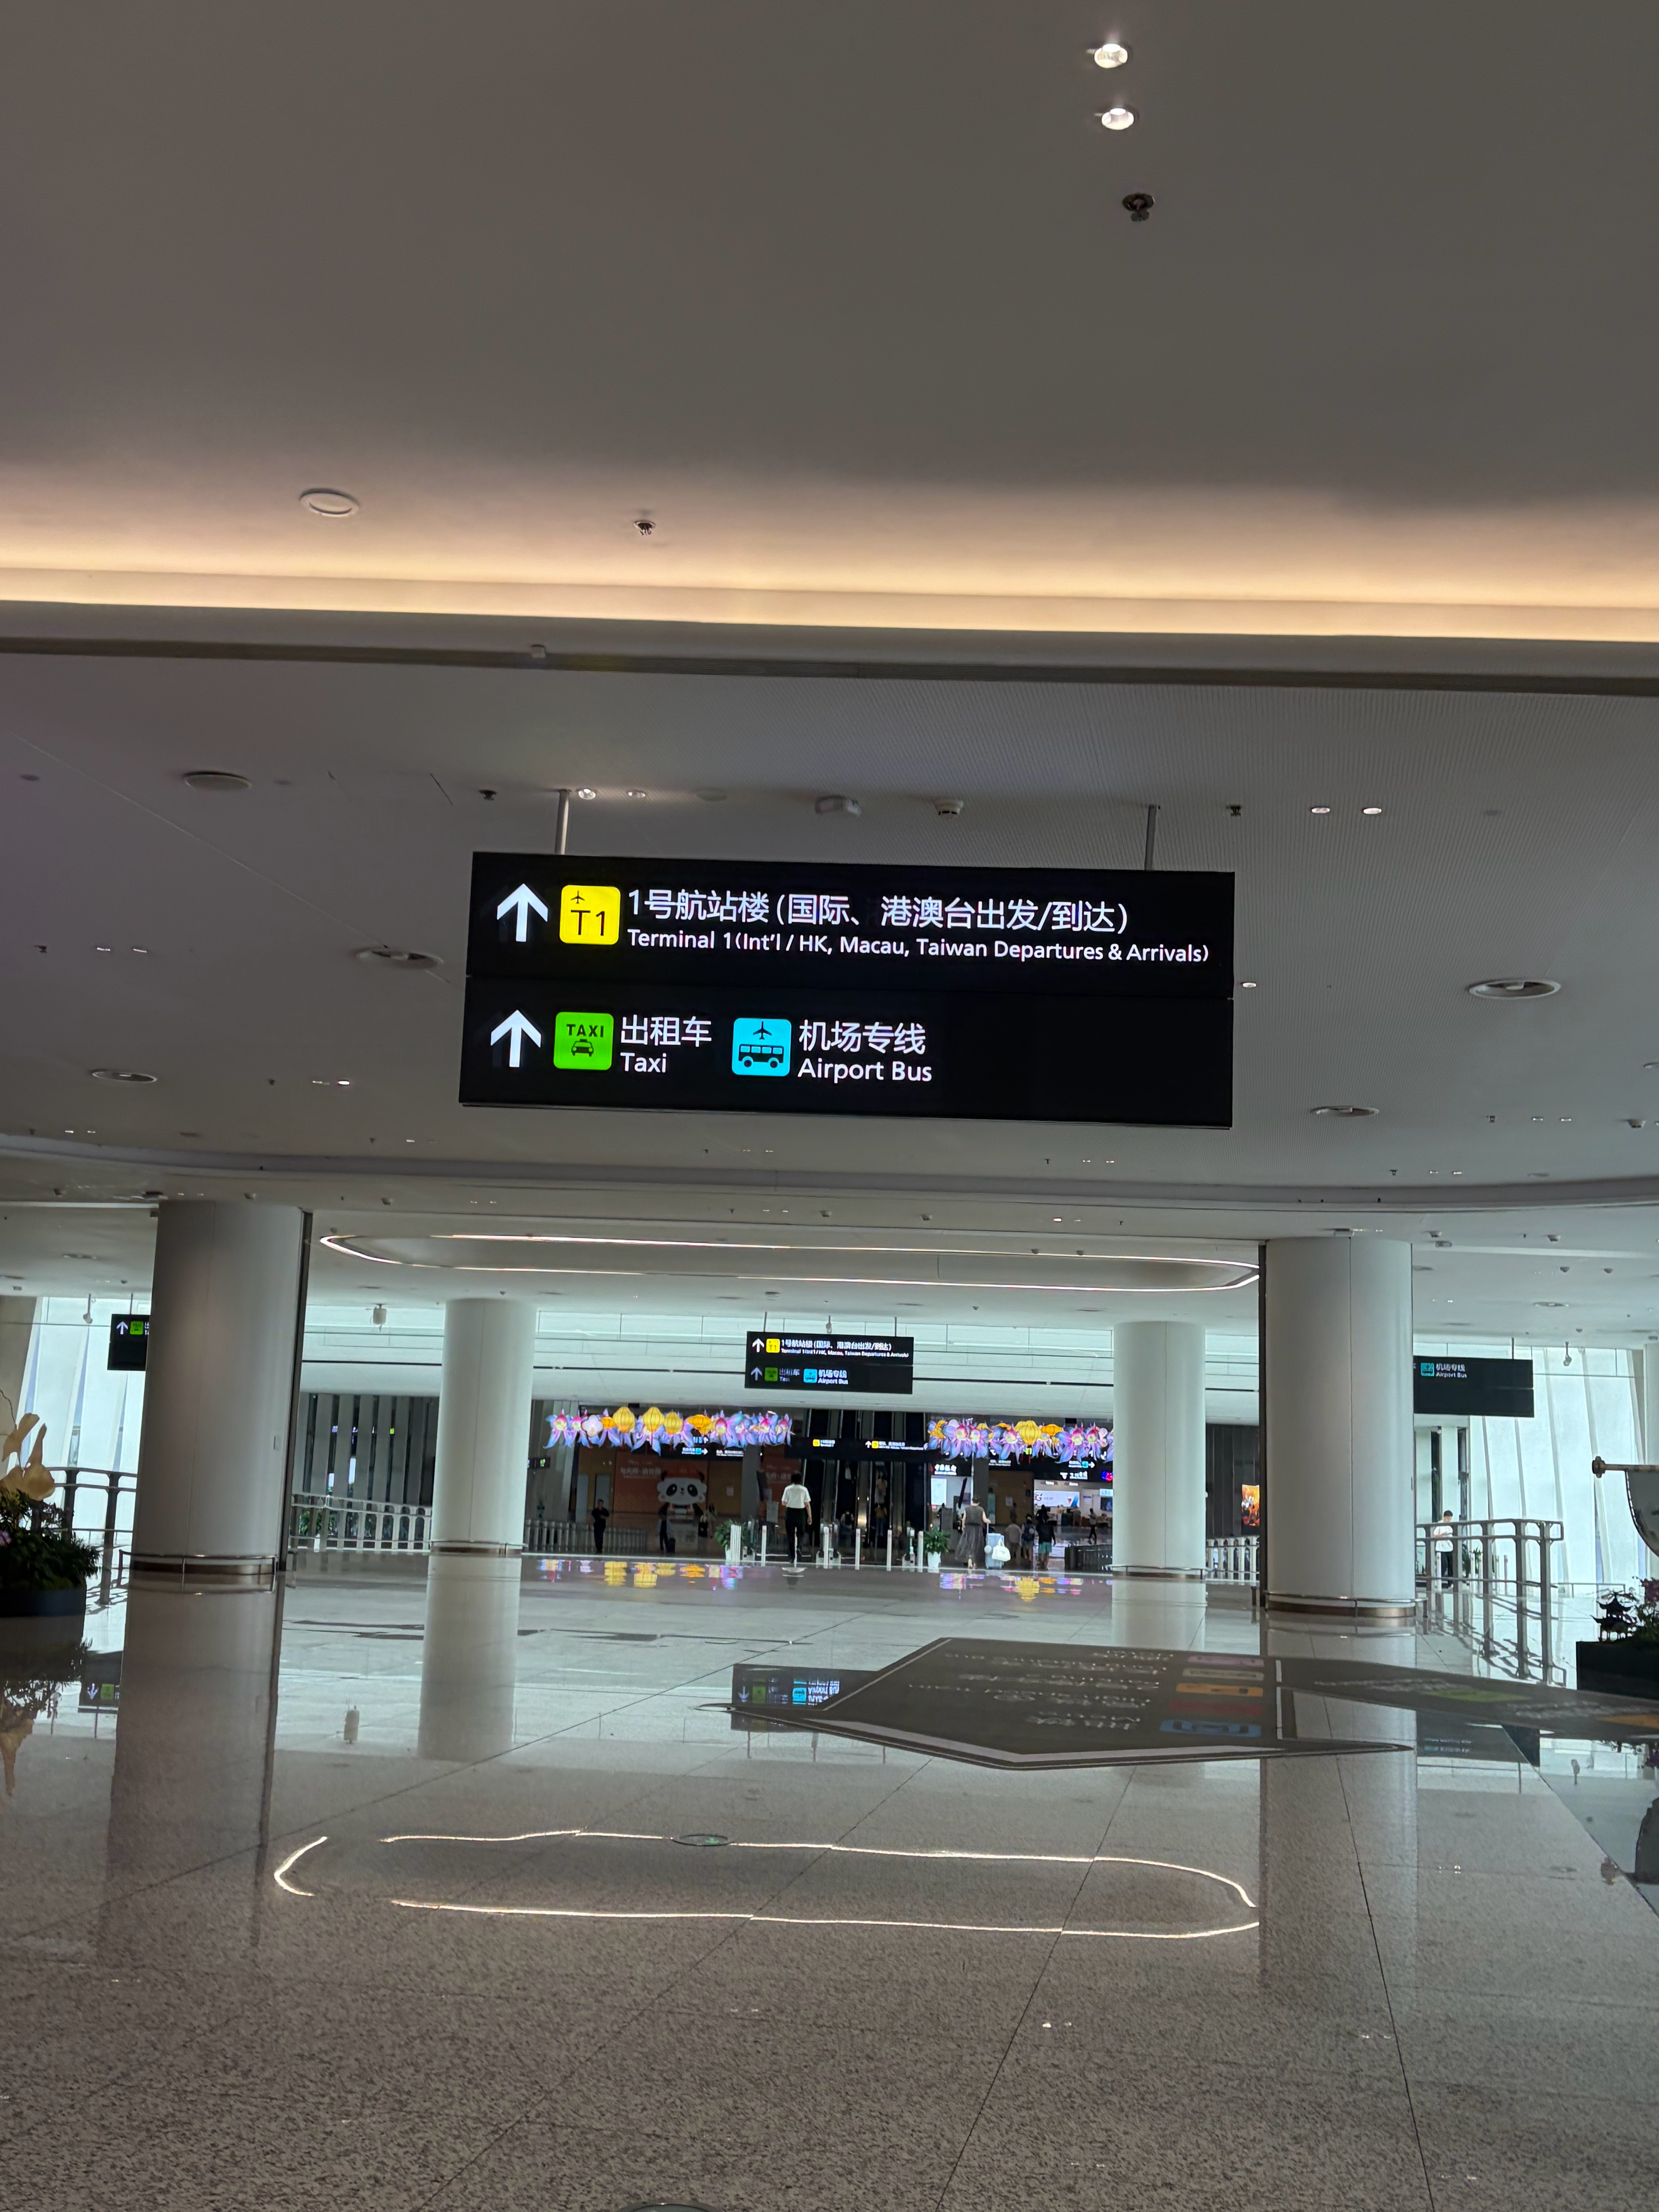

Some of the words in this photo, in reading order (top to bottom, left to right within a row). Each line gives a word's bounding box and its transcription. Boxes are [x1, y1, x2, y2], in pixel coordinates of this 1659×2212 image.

[570, 910, 605, 936] T1
[627, 929, 714, 949] Terminal
[800, 935, 832, 955] HK,
[840, 936, 909, 957] Macau,
[916, 938, 987, 957] Taiwan
[994, 940, 1103, 962] Departures
[1108, 943, 1122, 960] &
[1126, 944, 1209, 962] Arrivals)
[566, 1024, 604, 1038] TAXI
[620, 1014, 712, 1047] 出租车
[799, 1019, 926, 1054] 机场专线
[620, 1052, 667, 1073] Taxi
[797, 1058, 884, 1084] Airport
[892, 1061, 932, 1082] Bus
